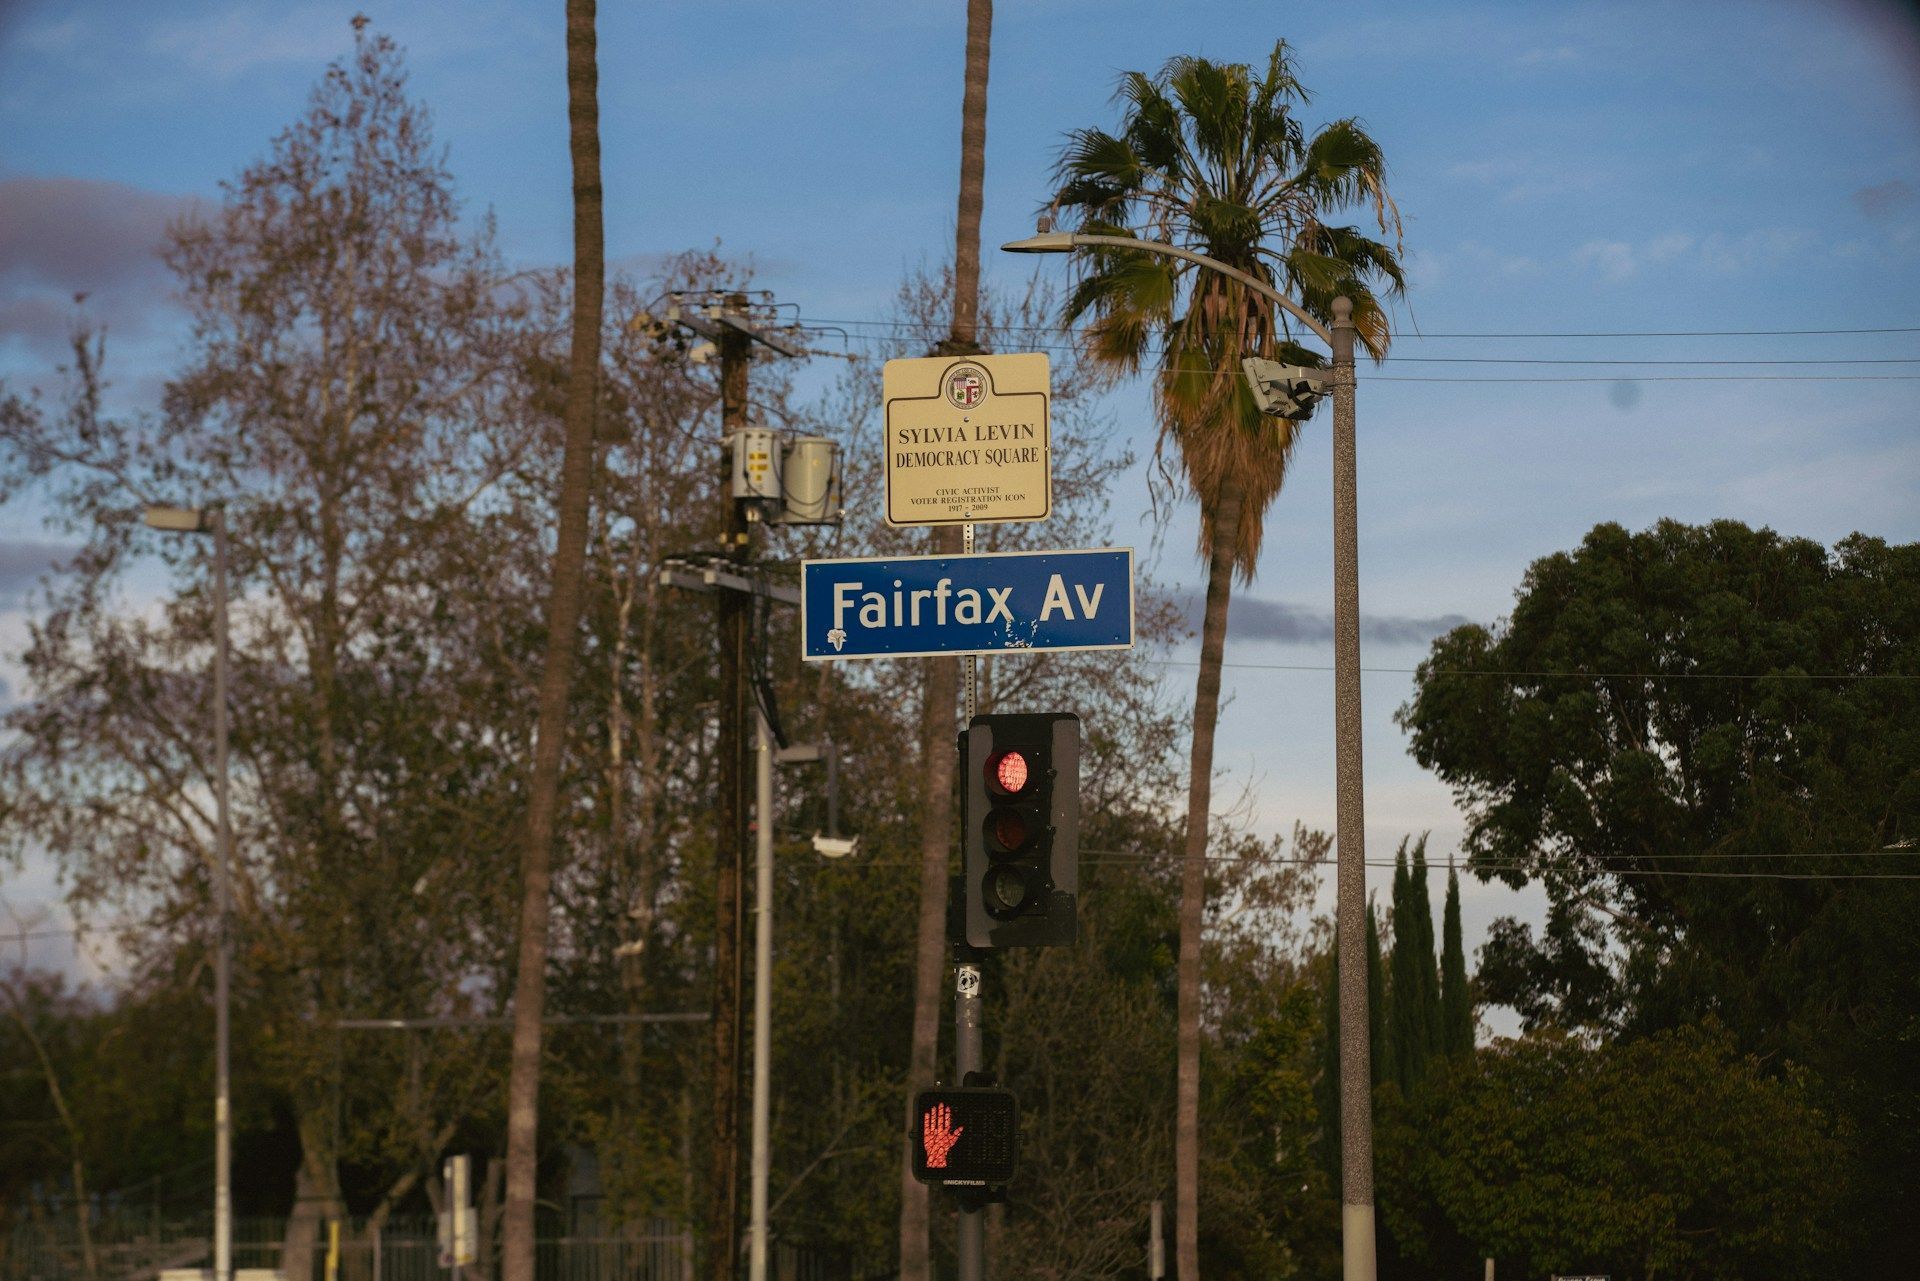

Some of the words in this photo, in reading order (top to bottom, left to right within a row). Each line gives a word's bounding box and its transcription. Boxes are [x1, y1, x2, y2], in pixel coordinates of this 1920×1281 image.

[898, 426, 967, 444] SYLVIA
[975, 424, 1034, 441] LEVIN
[896, 449, 980, 468] DEMOCRACY
[985, 447, 1039, 467] SQUARE
[936, 488, 959, 496] CIVIC
[962, 487, 1000, 495] ACTIVIST
[911, 497, 938, 505] VOTER
[941, 495, 1002, 504] REGISTRATION
[948, 504, 963, 512] 1917
[833, 578, 1014, 630] Fairfax
[1039, 573, 1104, 622] Av
